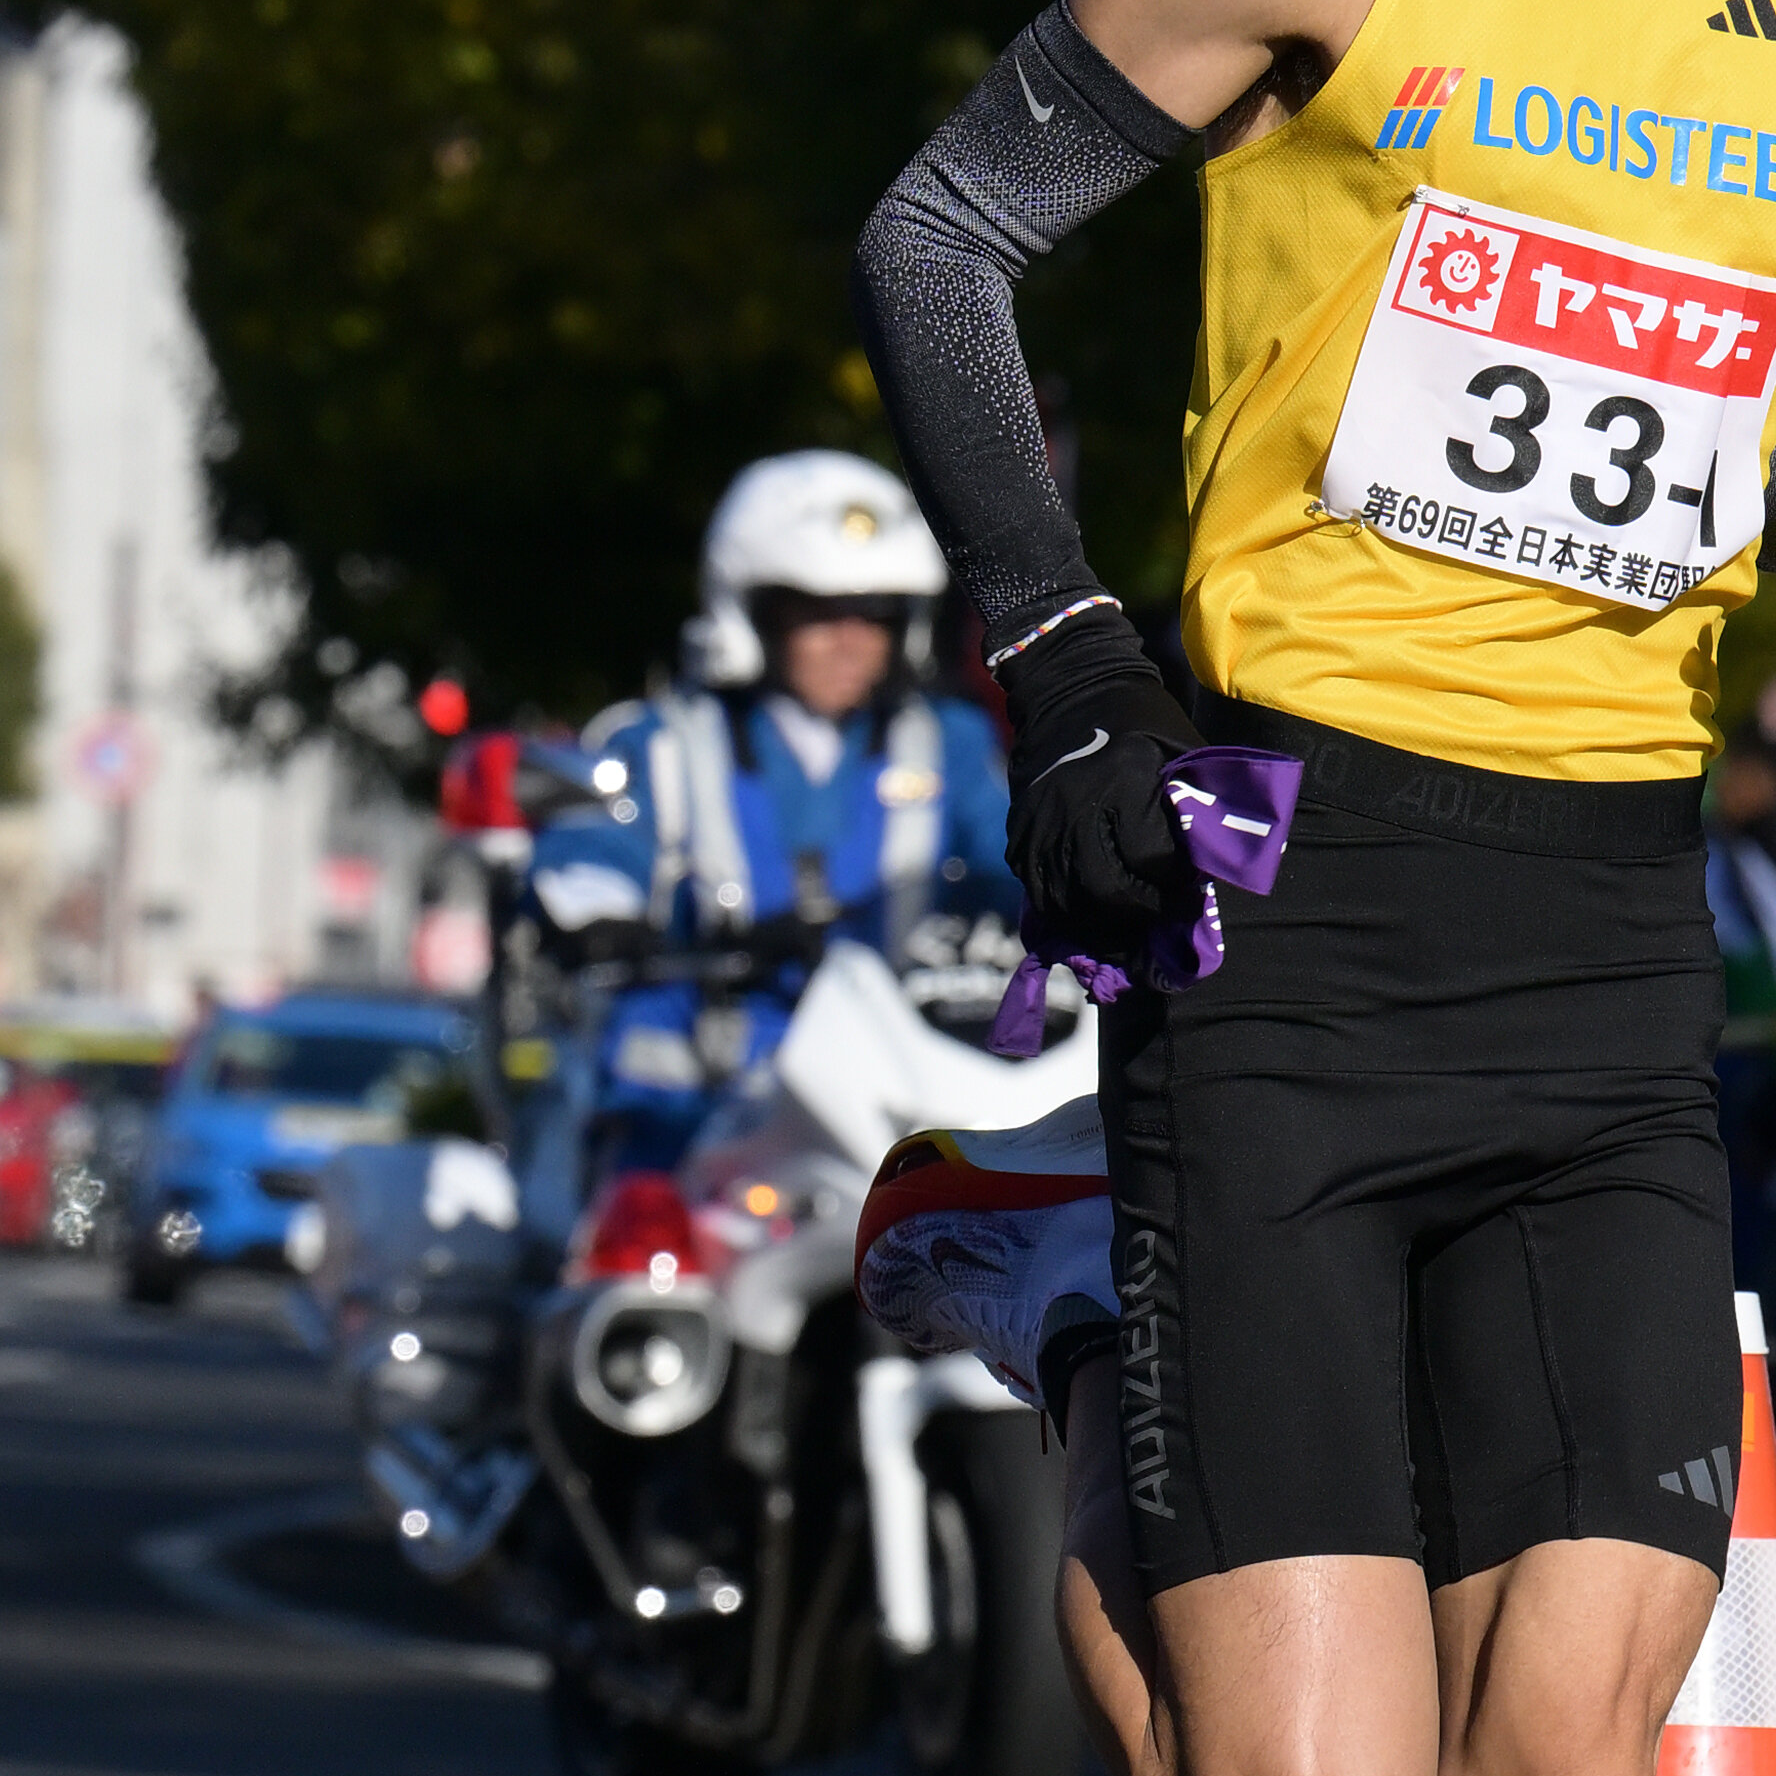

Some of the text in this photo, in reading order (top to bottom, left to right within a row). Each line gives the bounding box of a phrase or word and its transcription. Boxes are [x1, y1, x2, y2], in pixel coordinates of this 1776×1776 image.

[1530, 263, 1760, 369] ヤマザ
[1361, 482, 1717, 603] 第69回全日本実業団駅
[1119, 1229, 1177, 1521] ADIZERO
